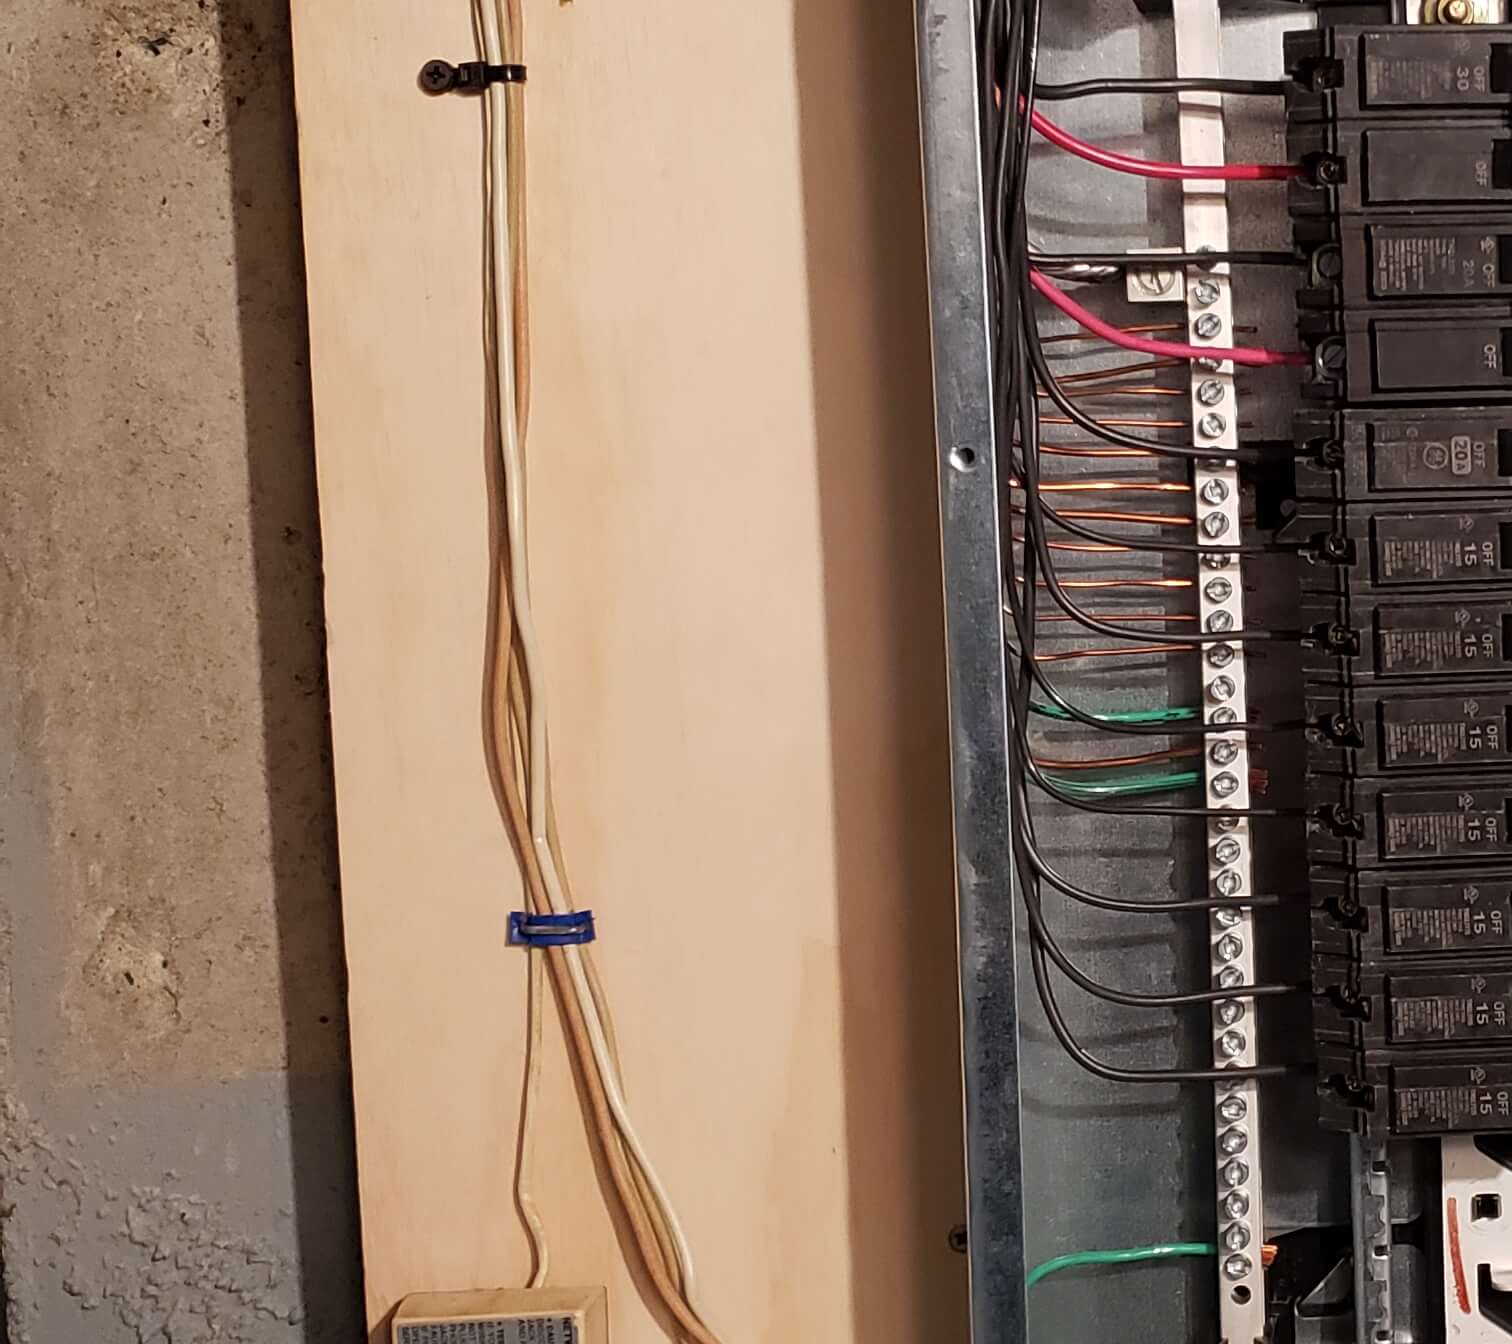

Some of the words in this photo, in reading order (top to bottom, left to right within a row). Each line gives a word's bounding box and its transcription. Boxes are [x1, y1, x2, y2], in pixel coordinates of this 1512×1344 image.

[1456, 65, 1470, 92] 30
[1472, 65, 1486, 93] OFF
[1474, 159, 1488, 187] OFF
[1461, 258, 1476, 288] 20A
[1481, 262, 1497, 289] OFF
[1482, 342, 1498, 369] OFF
[1453, 439, 1468, 472] 20A
[1472, 440, 1486, 469] OFF
[1463, 541, 1478, 566] 15
[1480, 540, 1495, 567] OFF
[1463, 633, 1478, 658] 15
[1480, 632, 1495, 658] OFF
[1468, 725, 1483, 750] 15
[1485, 724, 1500, 751] OFF
[1466, 817, 1481, 842] 15
[1484, 816, 1499, 843] OFF
[1472, 910, 1487, 935] 15
[1489, 909, 1504, 935] OFF
[1475, 1001, 1490, 1025] 15
[1493, 1000, 1506, 1026] OFF
[1479, 1092, 1493, 1115] 15
[1496, 1090, 1510, 1116] OFF
